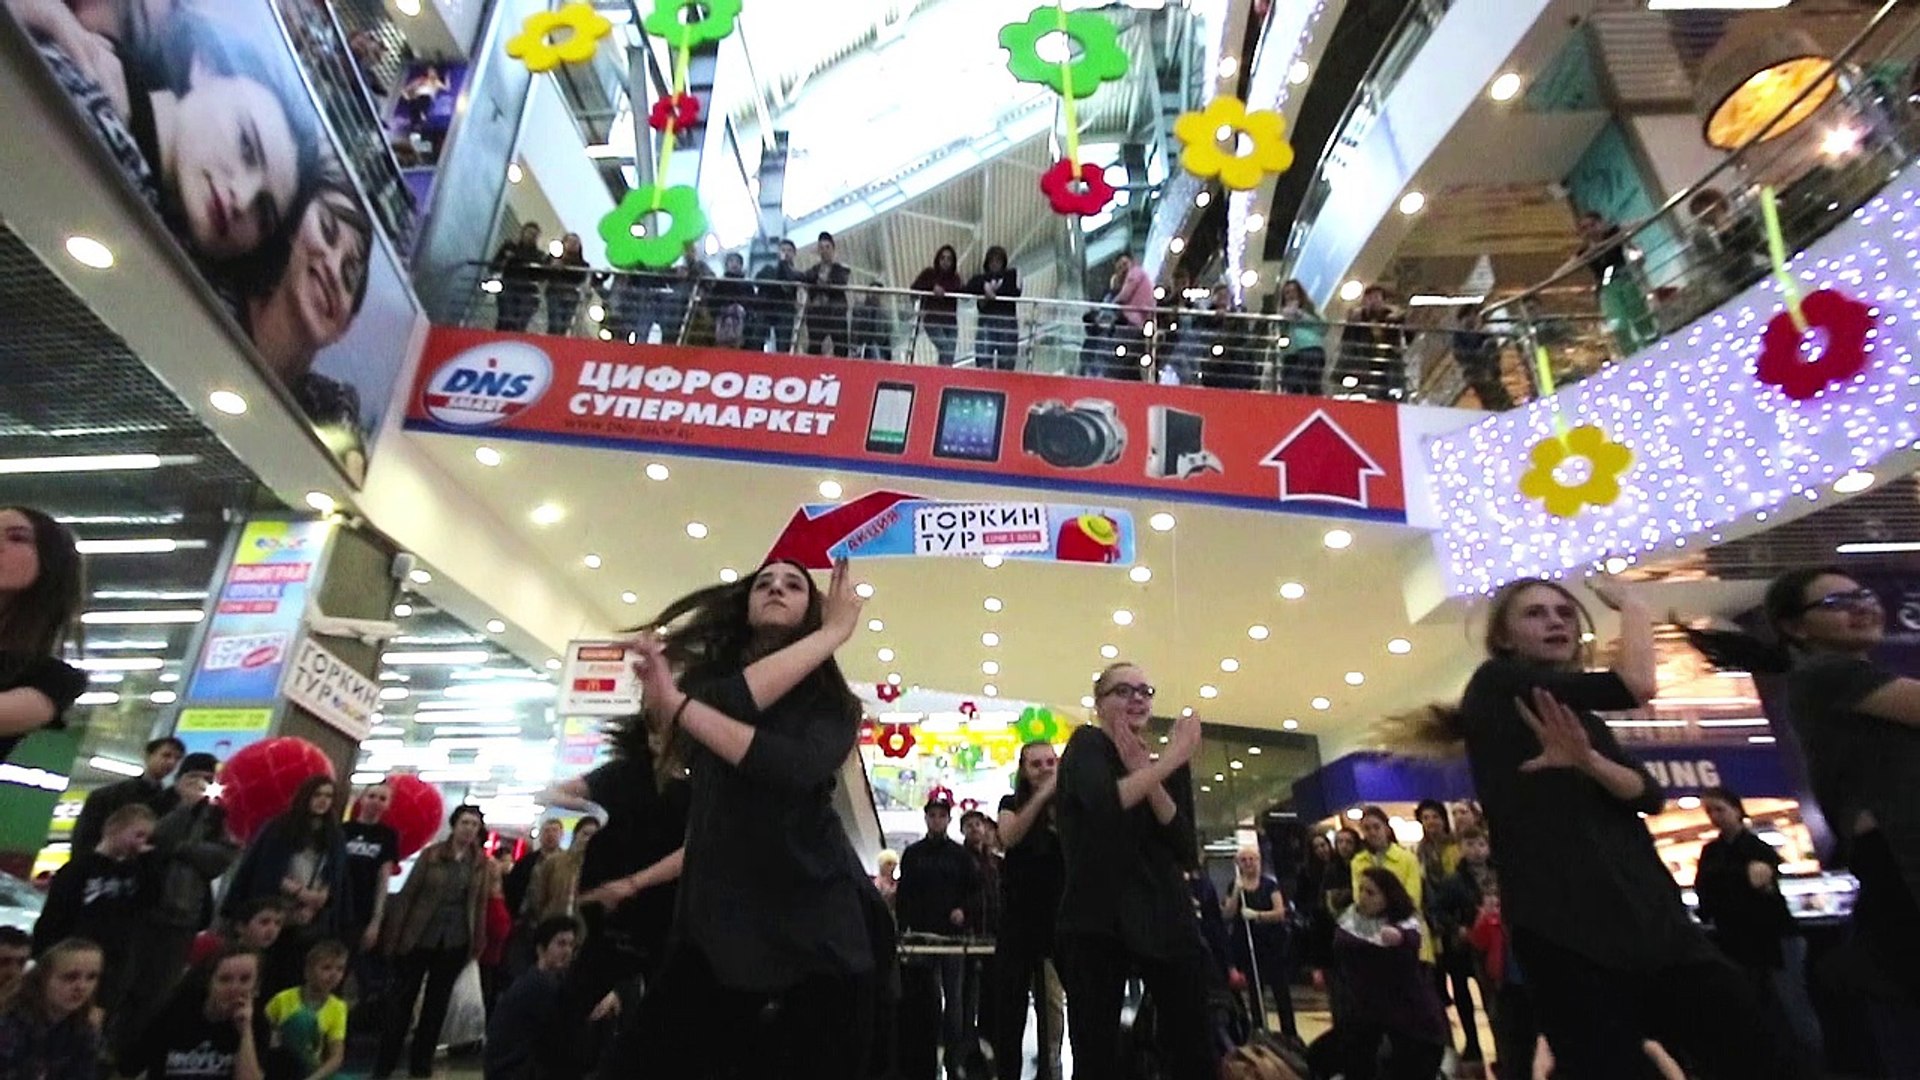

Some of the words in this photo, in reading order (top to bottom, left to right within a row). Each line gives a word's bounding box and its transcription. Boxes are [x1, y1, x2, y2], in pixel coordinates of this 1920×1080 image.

[442, 368, 535, 398] DNS
[578, 361, 841, 407] ЦИФРОВОЙ
[568, 392, 835, 435] СУПЕРМАРКЕТ
[847, 510, 902, 552] АКЦИЯ
[921, 507, 1040, 531] ГОРКИН
[922, 531, 976, 552] ТУР
[295, 665, 333, 702] ТУР
[300, 643, 378, 709] ГОРКИН
